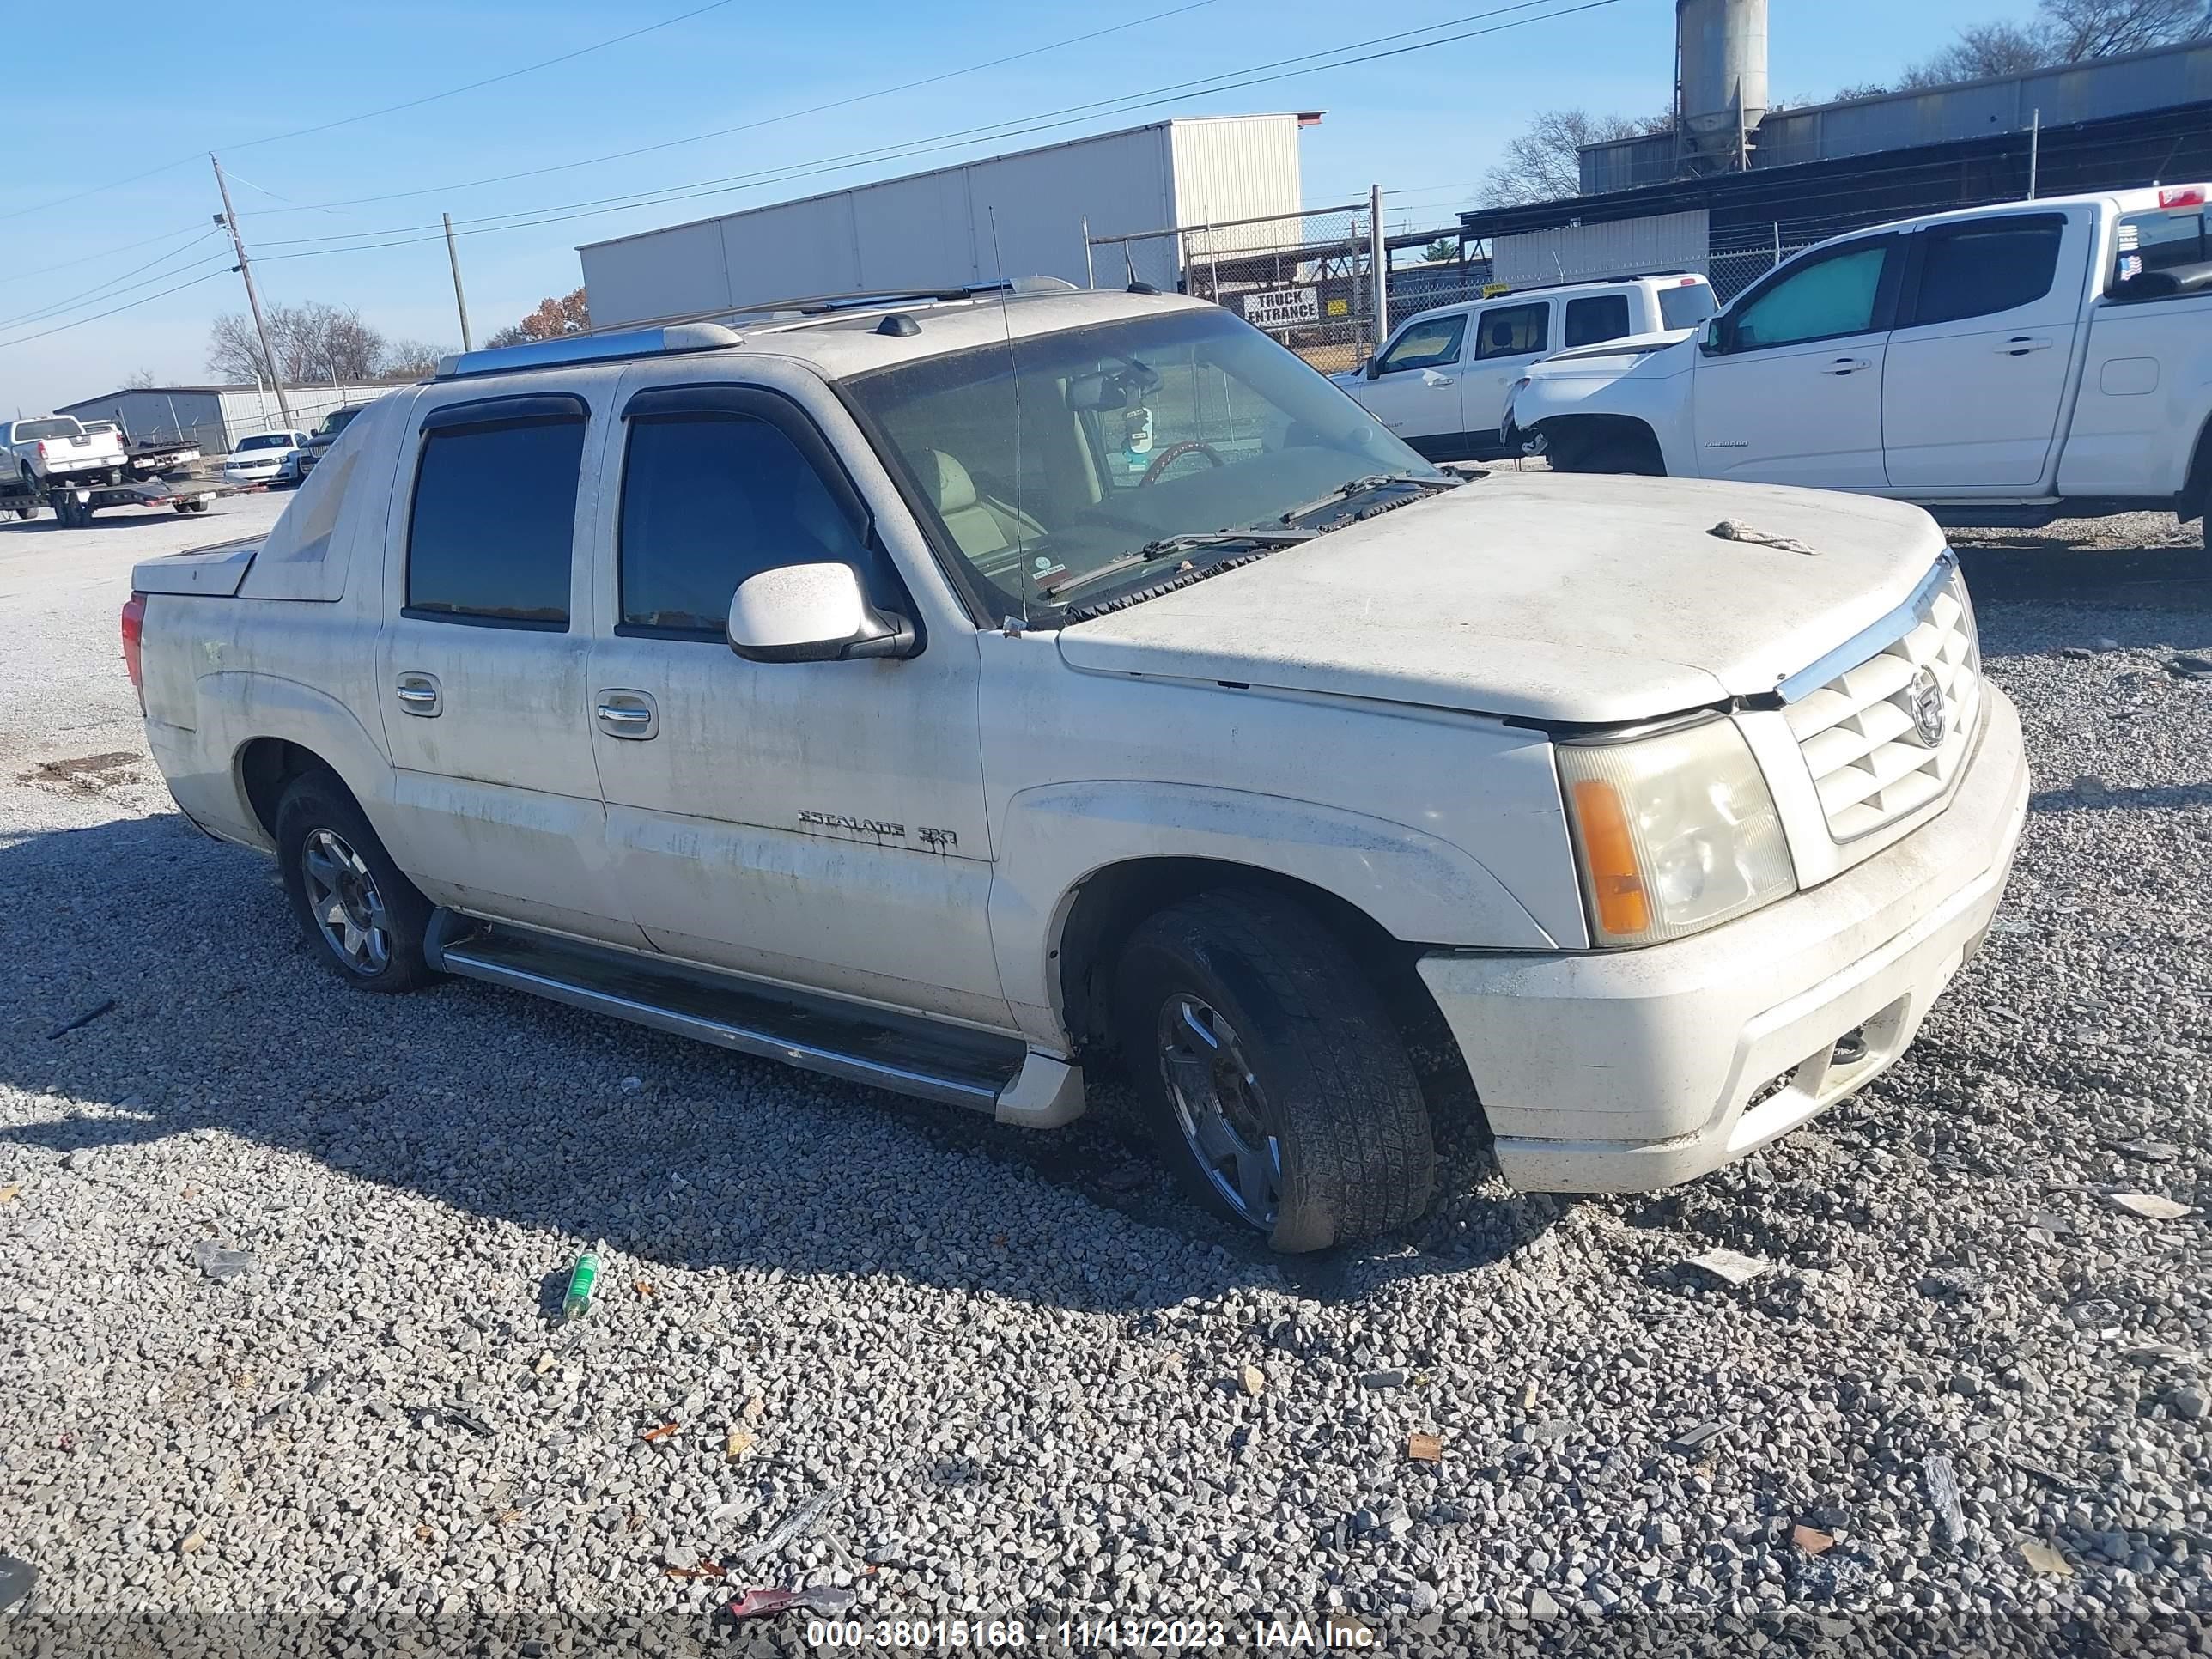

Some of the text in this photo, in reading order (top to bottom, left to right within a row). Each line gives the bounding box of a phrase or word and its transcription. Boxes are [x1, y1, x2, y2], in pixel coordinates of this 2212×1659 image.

[1258, 290, 1303, 307] TRUCK
[1248, 304, 1316, 323] ENTRANCE
[797, 809, 906, 838] ESCALADE
